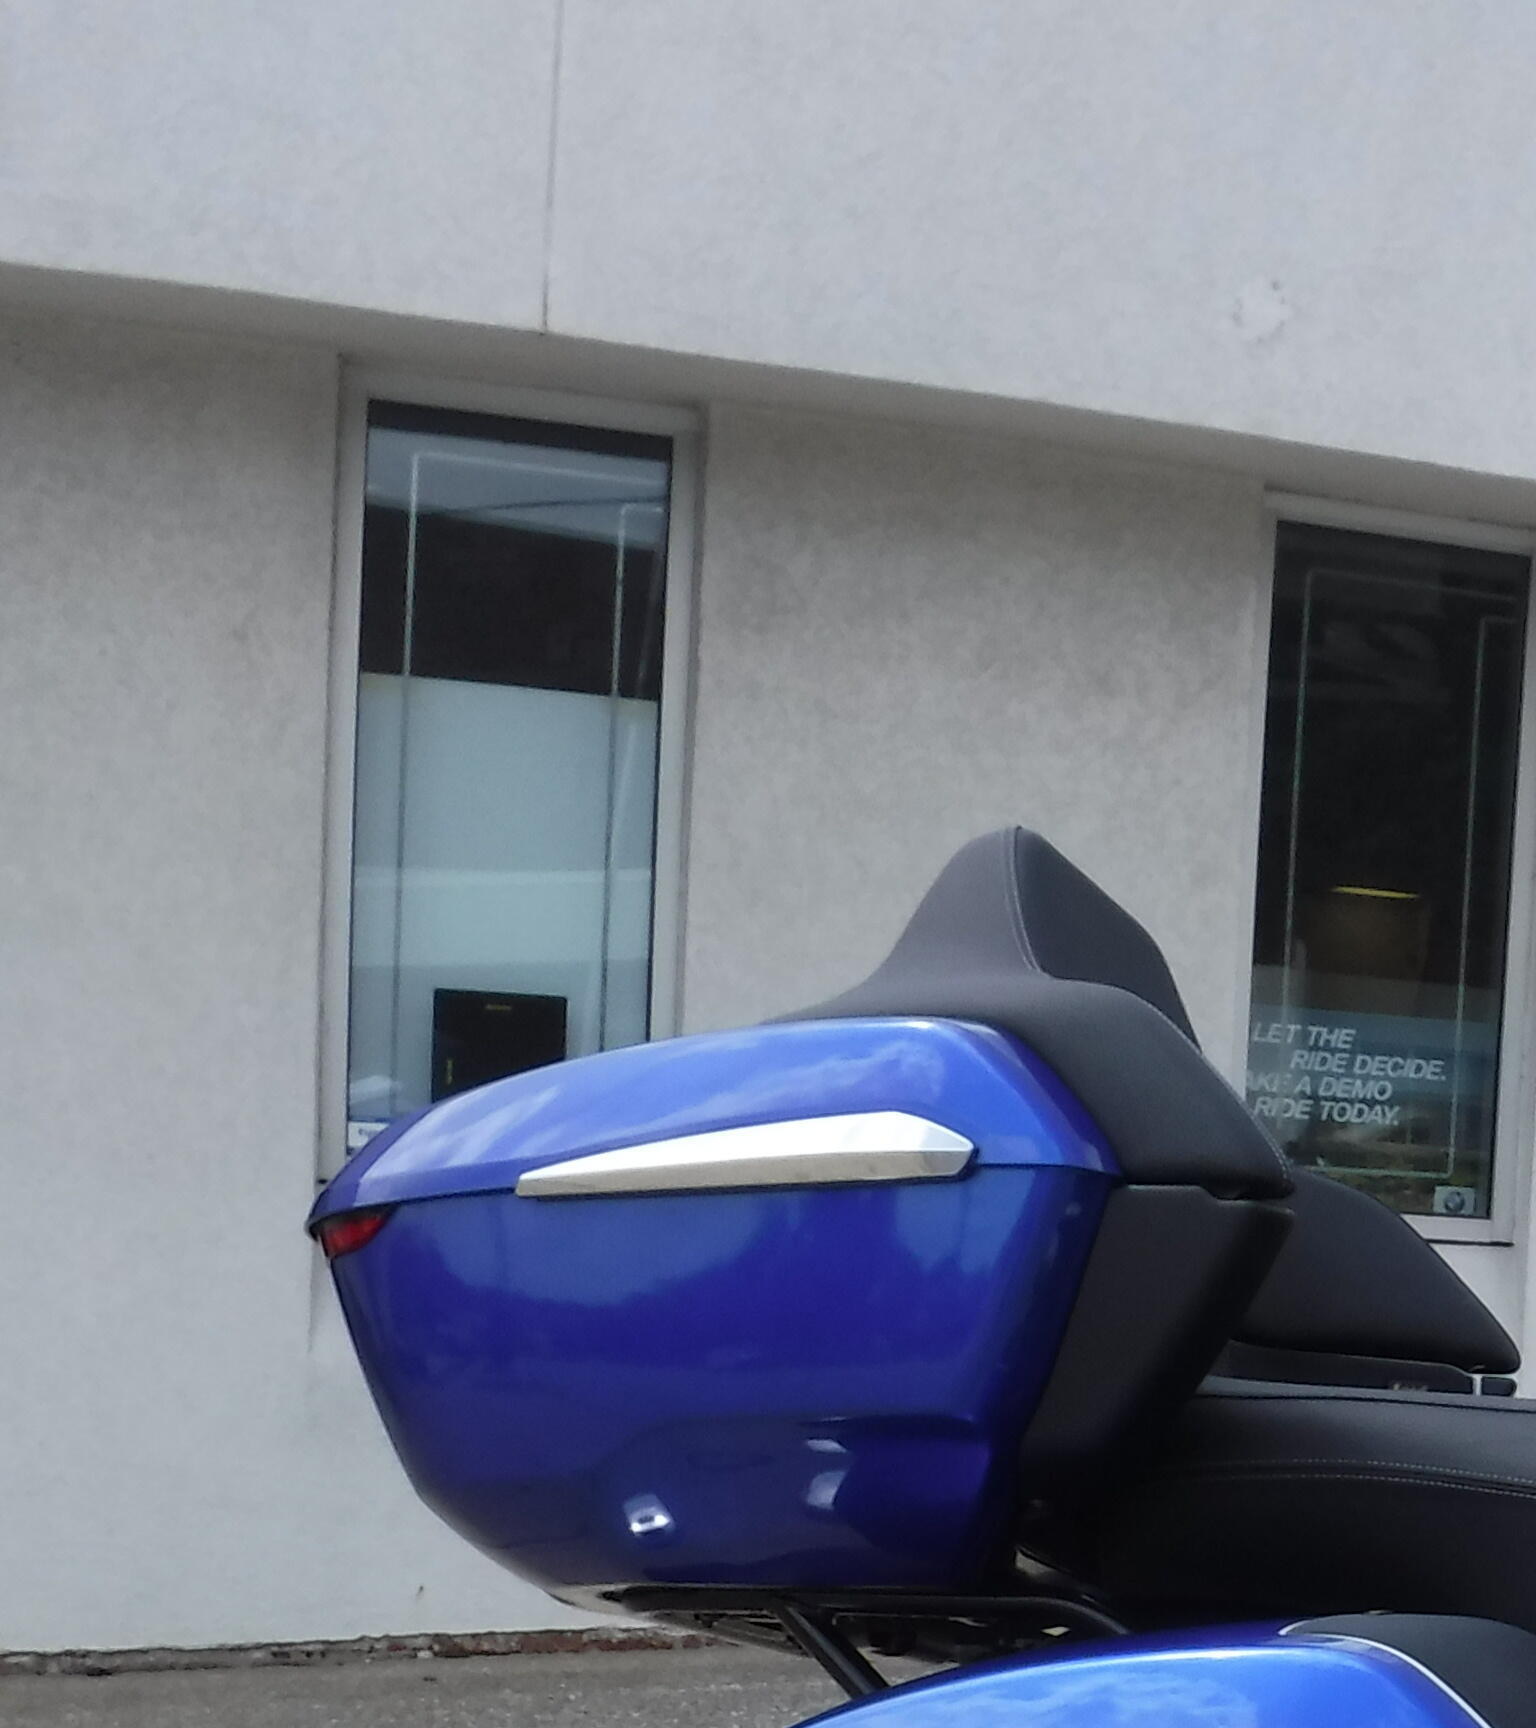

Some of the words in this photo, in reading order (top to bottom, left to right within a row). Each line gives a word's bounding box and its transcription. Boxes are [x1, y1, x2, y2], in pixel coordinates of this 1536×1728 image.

[1253, 1022, 1302, 1044] LET
[1307, 1025, 1356, 1049] THE
[1290, 1049, 1349, 1073] RIDE
[1352, 1053, 1447, 1081] DECIDE.
[1294, 1074, 1312, 1096] A
[1318, 1076, 1393, 1101] DEMO
[1253, 1096, 1314, 1120] RIDE
[1319, 1100, 1400, 1126] TODAY.
